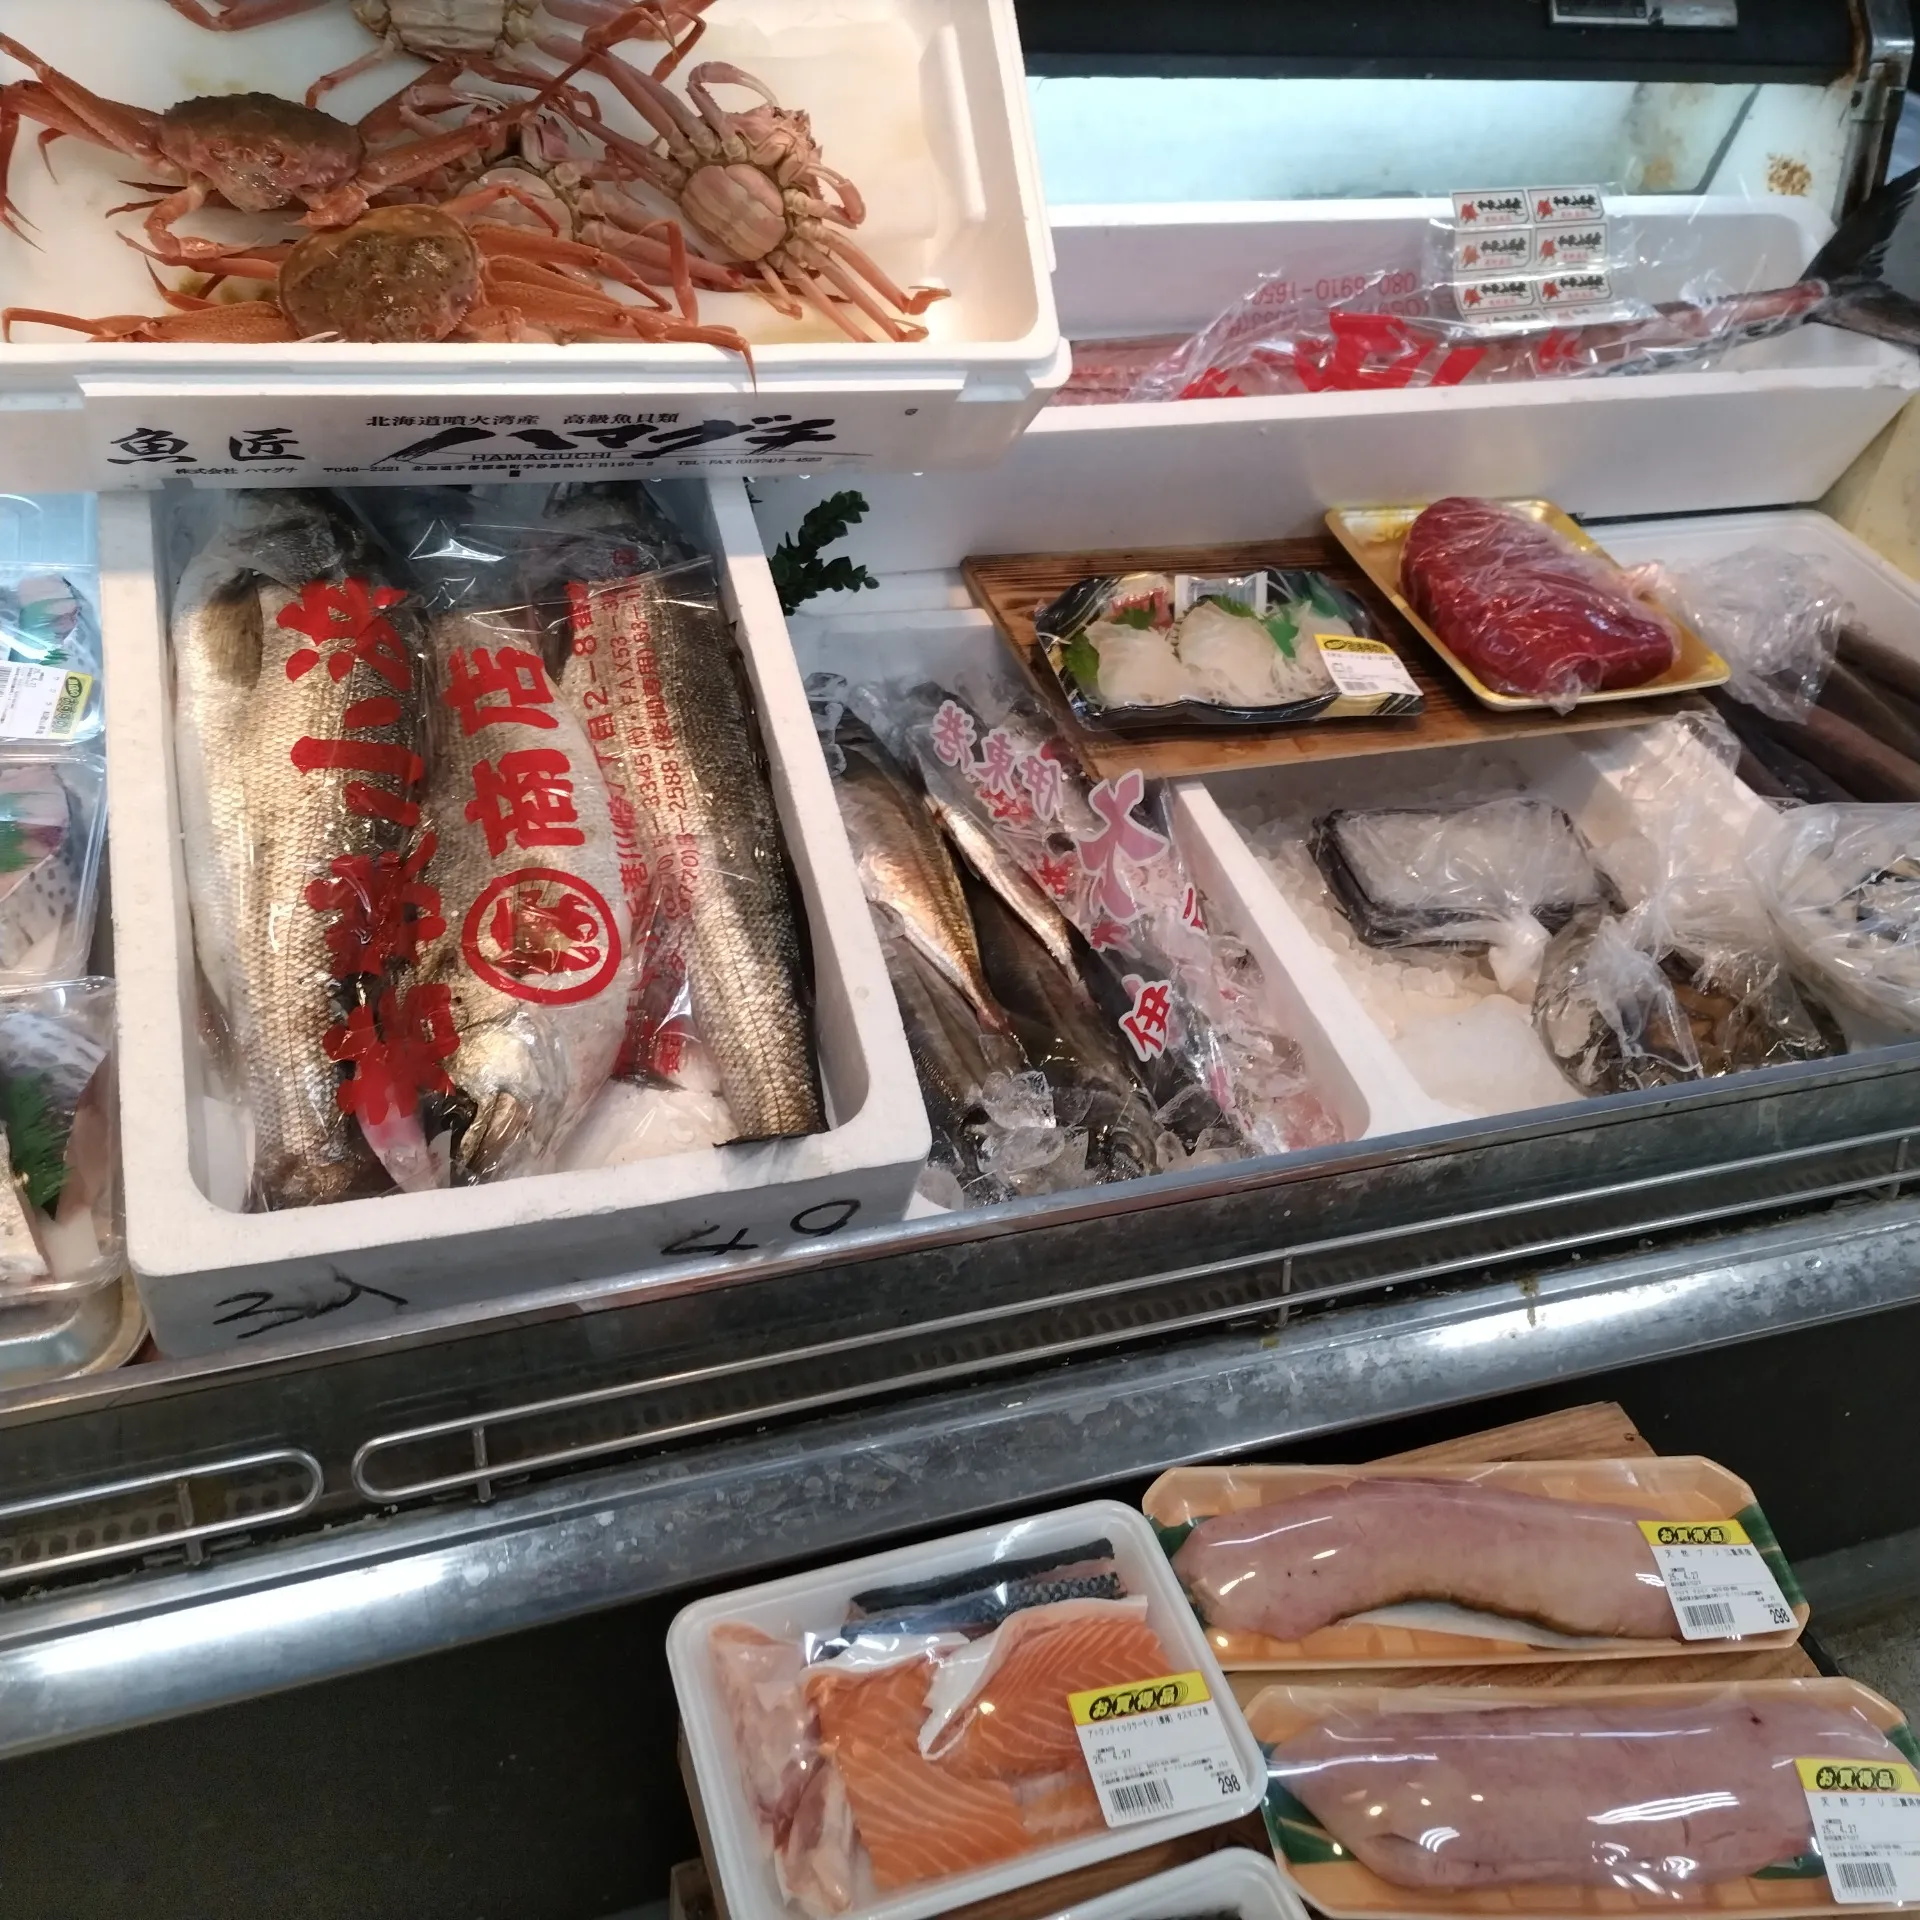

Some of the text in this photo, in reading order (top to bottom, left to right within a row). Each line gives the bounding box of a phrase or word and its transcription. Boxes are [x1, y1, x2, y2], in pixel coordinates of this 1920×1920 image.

[365, 412, 679, 427] 北海道噴火湾産 高級魚貝類
[107, 427, 305, 465] 魚匠
[472, 451, 611, 462] HAMAGUCHI
[175, 467, 239, 475] 株式会社
[441, 643, 585, 860] 商店
[1769, 1608, 1791, 1625] 298
[1217, 1773, 1242, 1796] 298
